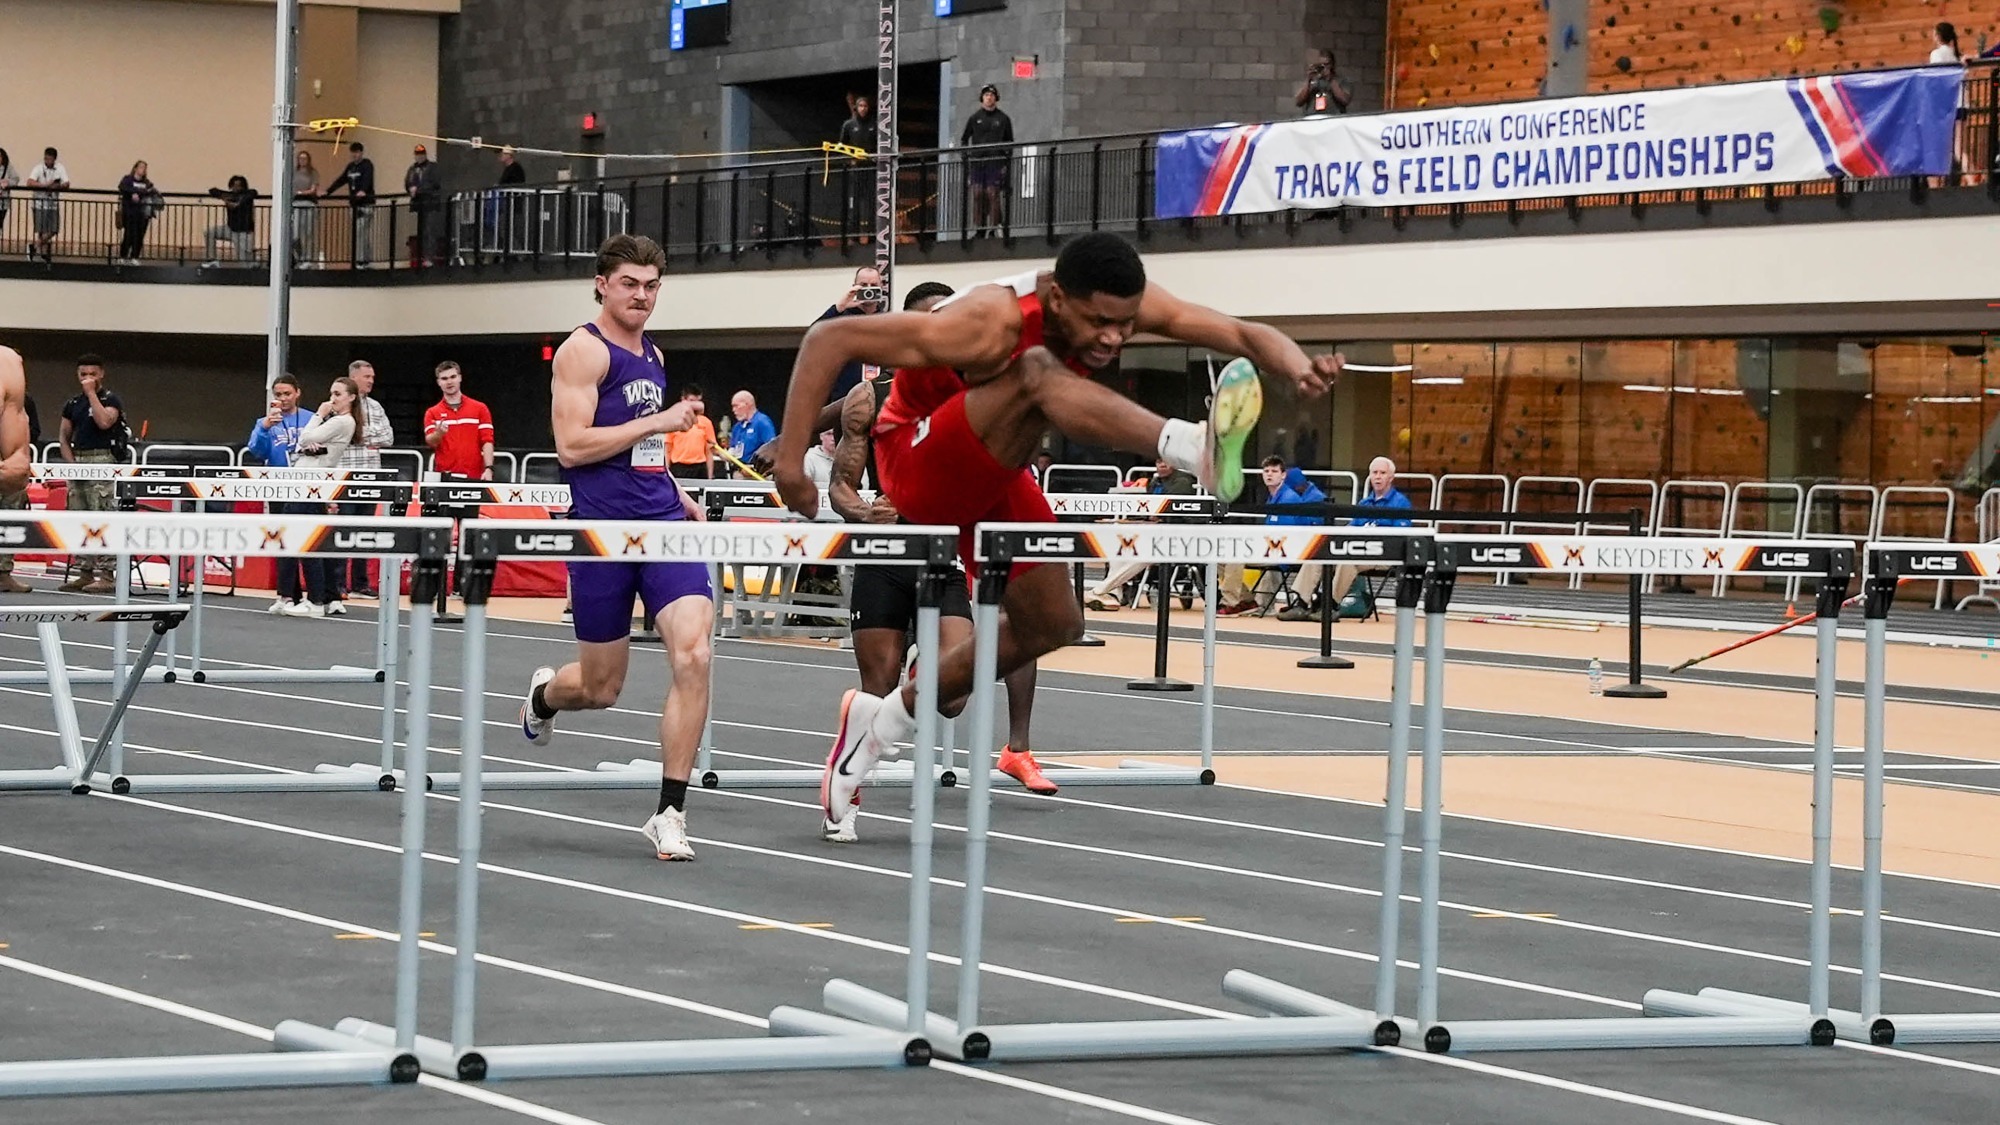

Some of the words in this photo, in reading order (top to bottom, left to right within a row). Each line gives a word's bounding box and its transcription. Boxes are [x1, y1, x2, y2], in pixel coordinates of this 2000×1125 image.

[1379, 117, 1492, 151] SOUTHERN
[1499, 103, 1646, 140] CONFERENCE
[877, 82, 893, 219] MILITARY
[1275, 160, 1363, 200] TRACK
[1372, 162, 1389, 194] &
[1399, 153, 1481, 194] FIELD
[1492, 131, 1775, 189] CHAMPIONSHIPS
[622, 378, 663, 407] WCU
[59, 468, 108, 478] KEYDETS
[274, 471, 321, 480] KEYDETS
[146, 485, 181, 494] UCS
[233, 486, 301, 499] KEYDETS
[348, 488, 381, 498] UCS
[449, 490, 481, 499] UCS
[733, 495, 764, 504] UCS
[1074, 501, 1132, 512] KEYDETS
[1172, 502, 1201, 511] UCS
[124, 527, 248, 550] KEYDETS
[334, 531, 395, 548] UCS
[515, 534, 573, 550] UCS
[661, 534, 773, 556] KEYDETS
[851, 539, 906, 554] UCS
[1025, 537, 1075, 552] UCS
[1151, 537, 1253, 557] KEYDETS
[1330, 540, 1384, 555] UCS
[1471, 547, 1521, 563] UCS
[1597, 548, 1694, 569] KEYDETS
[1761, 552, 1810, 566] UCS
[1910, 556, 1957, 570] UCS
